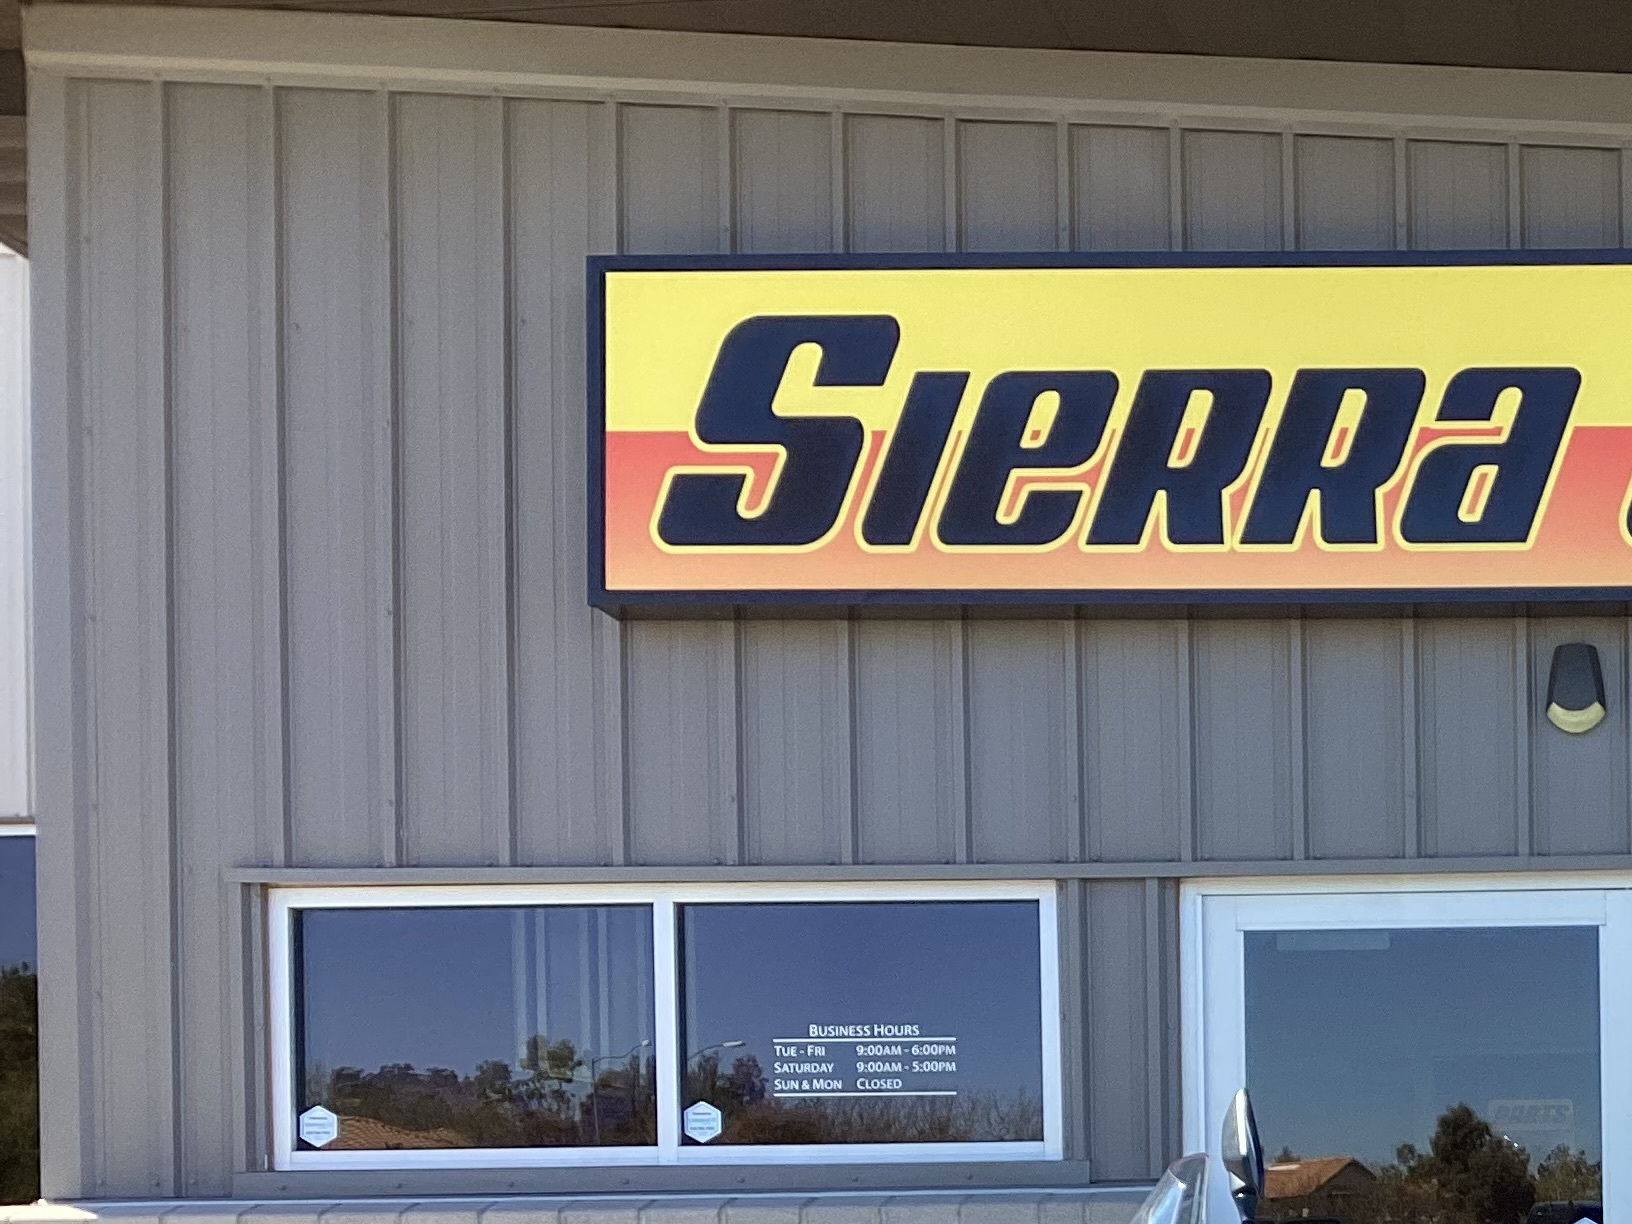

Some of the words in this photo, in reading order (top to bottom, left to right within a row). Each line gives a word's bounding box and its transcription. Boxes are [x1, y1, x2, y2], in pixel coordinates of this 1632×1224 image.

[856, 1045, 902, 1056] 9:00AM
[911, 1044, 956, 1056] 6:00PM
[774, 1062, 834, 1074] SATURDAY
[856, 1061, 902, 1073] 9:00AM
[911, 1061, 957, 1072] 5:00PM
[801, 1080, 810, 1091] &
